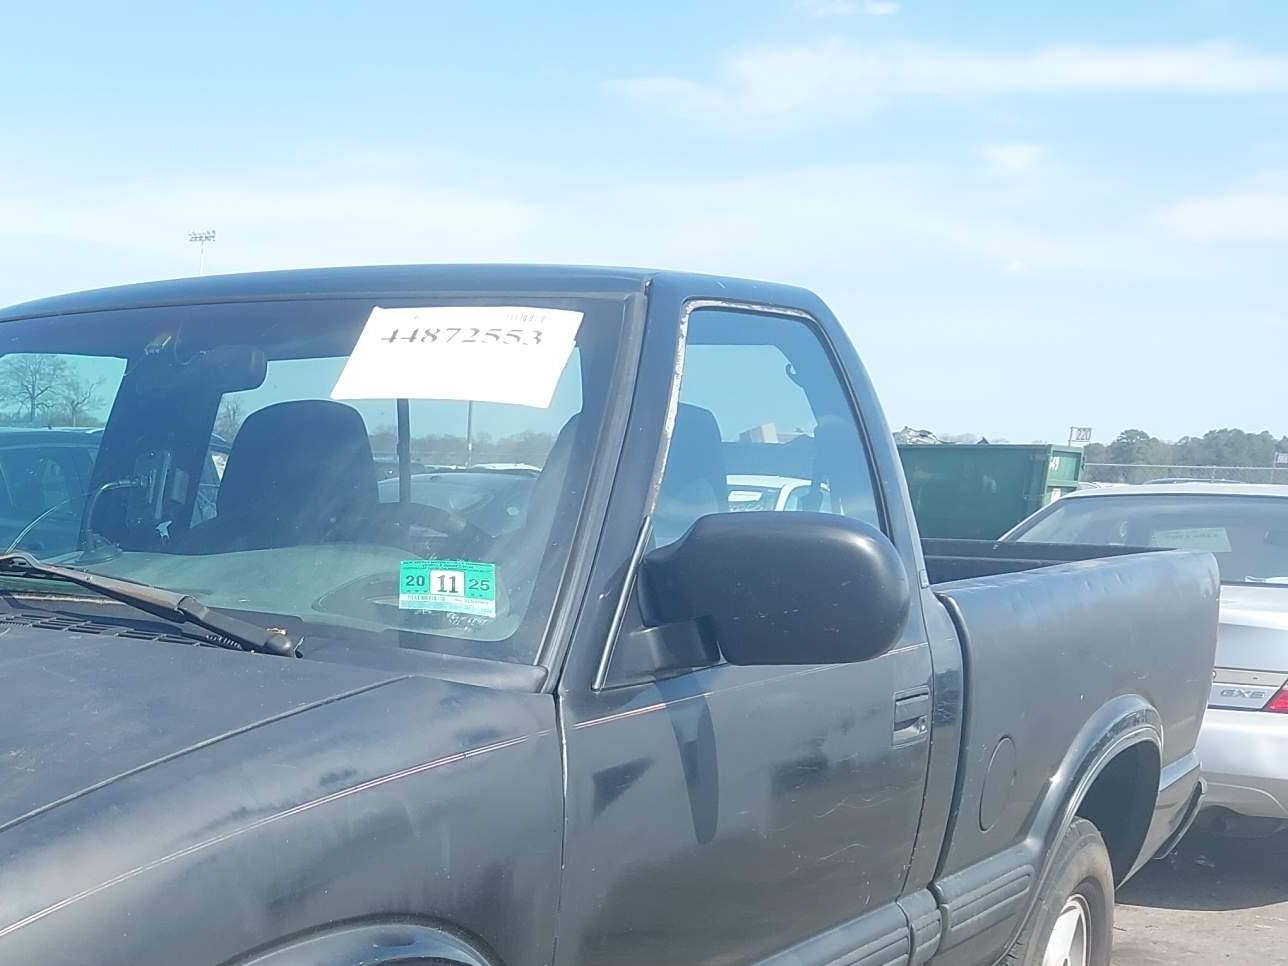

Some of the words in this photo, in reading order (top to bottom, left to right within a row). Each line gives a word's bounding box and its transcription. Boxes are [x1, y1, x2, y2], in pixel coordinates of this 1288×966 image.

[380, 327, 543, 345] 44872553
[405, 575, 426, 587] 20
[437, 574, 459, 593] 11
[468, 579, 490, 591] 25
